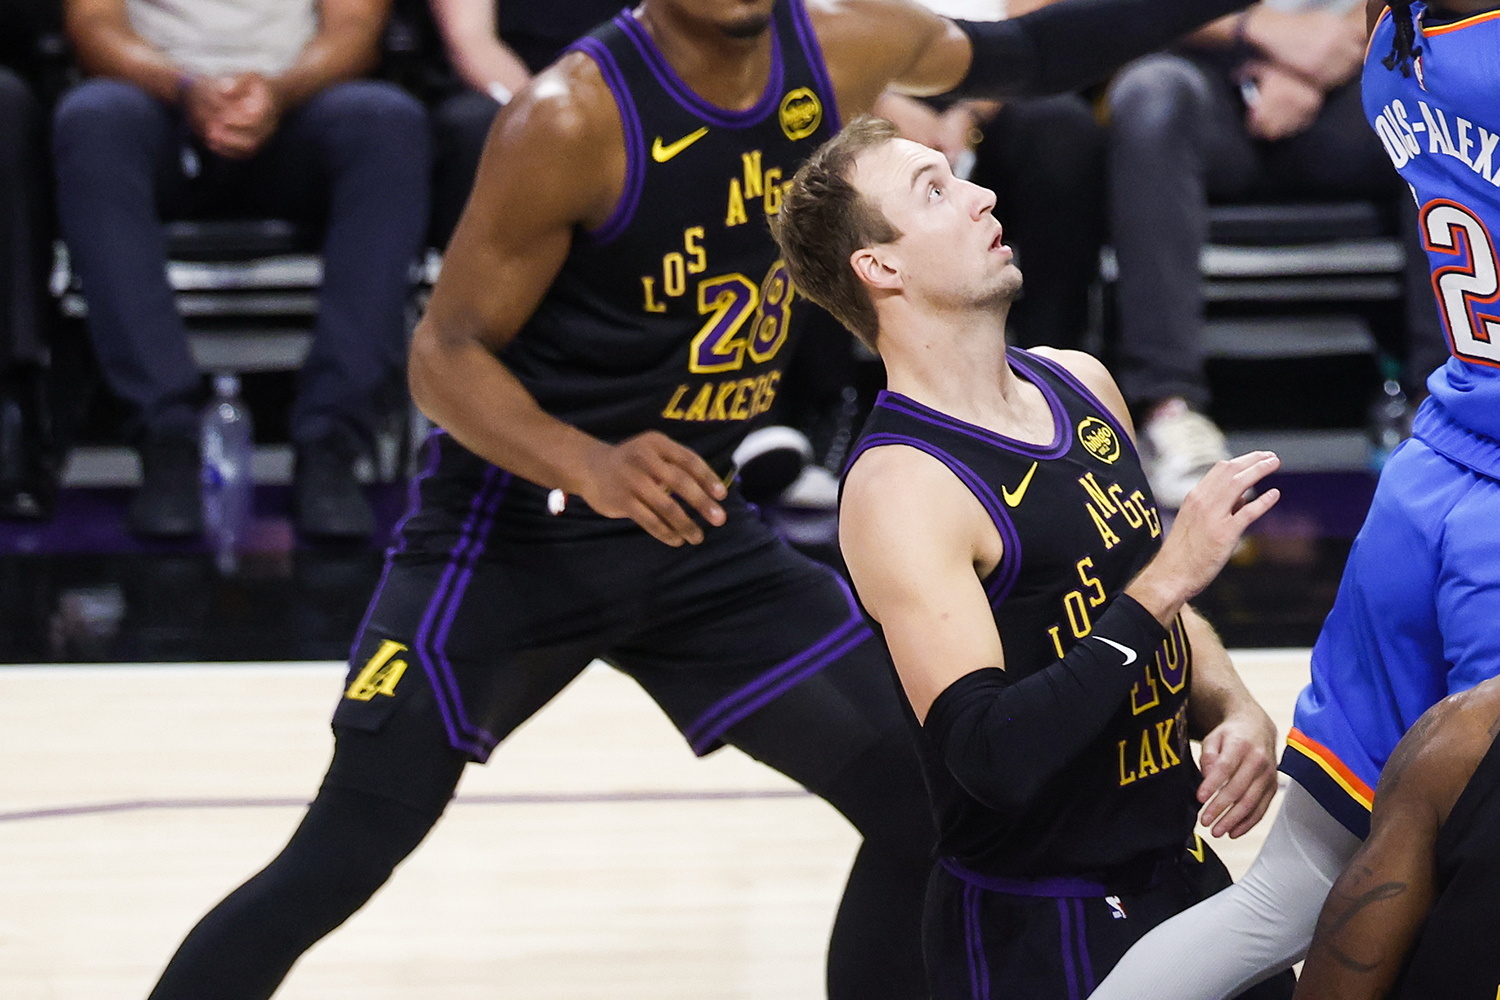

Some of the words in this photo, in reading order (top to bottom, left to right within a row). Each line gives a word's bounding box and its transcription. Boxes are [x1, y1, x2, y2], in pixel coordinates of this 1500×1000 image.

[641, 226, 707, 313] LOS
[688, 260, 797, 375] 28
[661, 369, 782, 421] LAKERS
